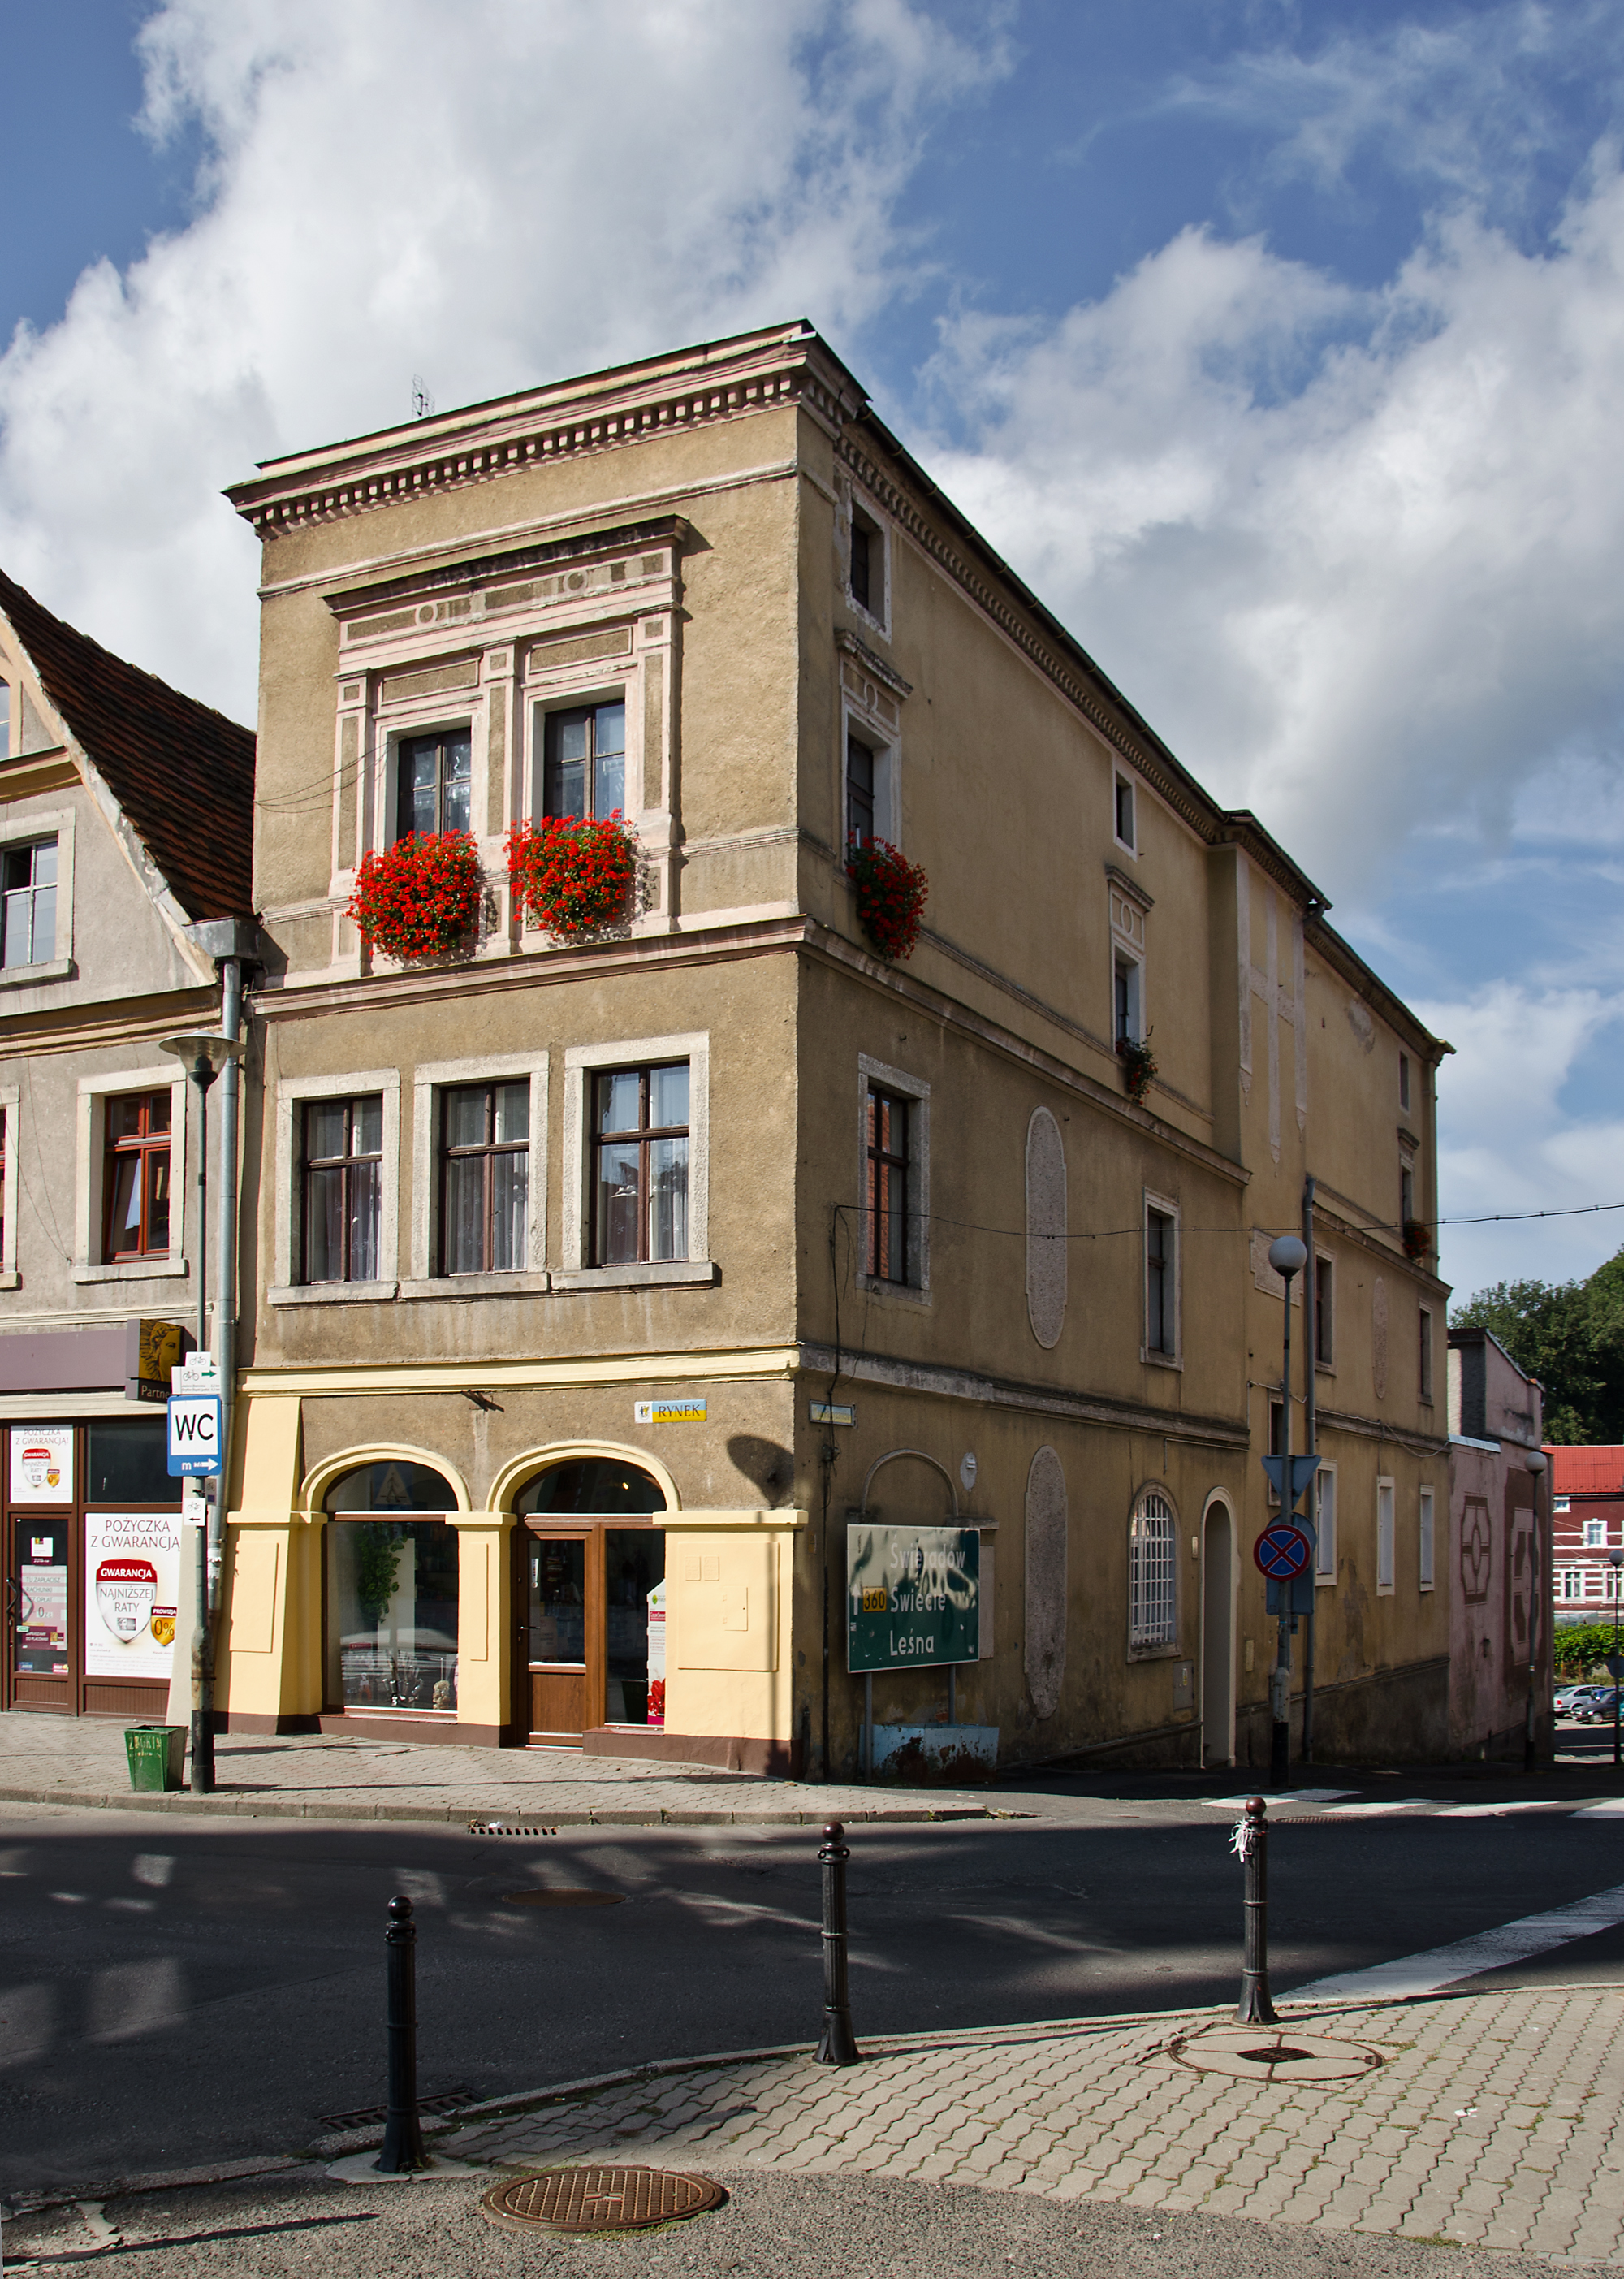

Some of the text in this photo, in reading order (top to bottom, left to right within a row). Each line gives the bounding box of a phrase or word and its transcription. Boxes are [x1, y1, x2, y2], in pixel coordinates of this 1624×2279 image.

[141, 1385, 171, 1399] Partne
[659, 1404, 701, 1417] RYNEK
[175, 1413, 214, 1441] WC
[106, 1516, 171, 1533] POŻYCZKA
[90, 1535, 180, 1551] Z GWARANCJĄ
[890, 1534, 965, 1568] Świeradów
[101, 1568, 153, 1579] GWARANCJA
[100, 1585, 153, 1601] NAJNIŻSZEJ
[864, 1590, 885, 1610] 360
[890, 1579, 946, 1612] Świecie
[114, 1602, 140, 1613] RATY
[154, 1619, 175, 1636] 0%
[890, 1628, 935, 1656] Leśna
